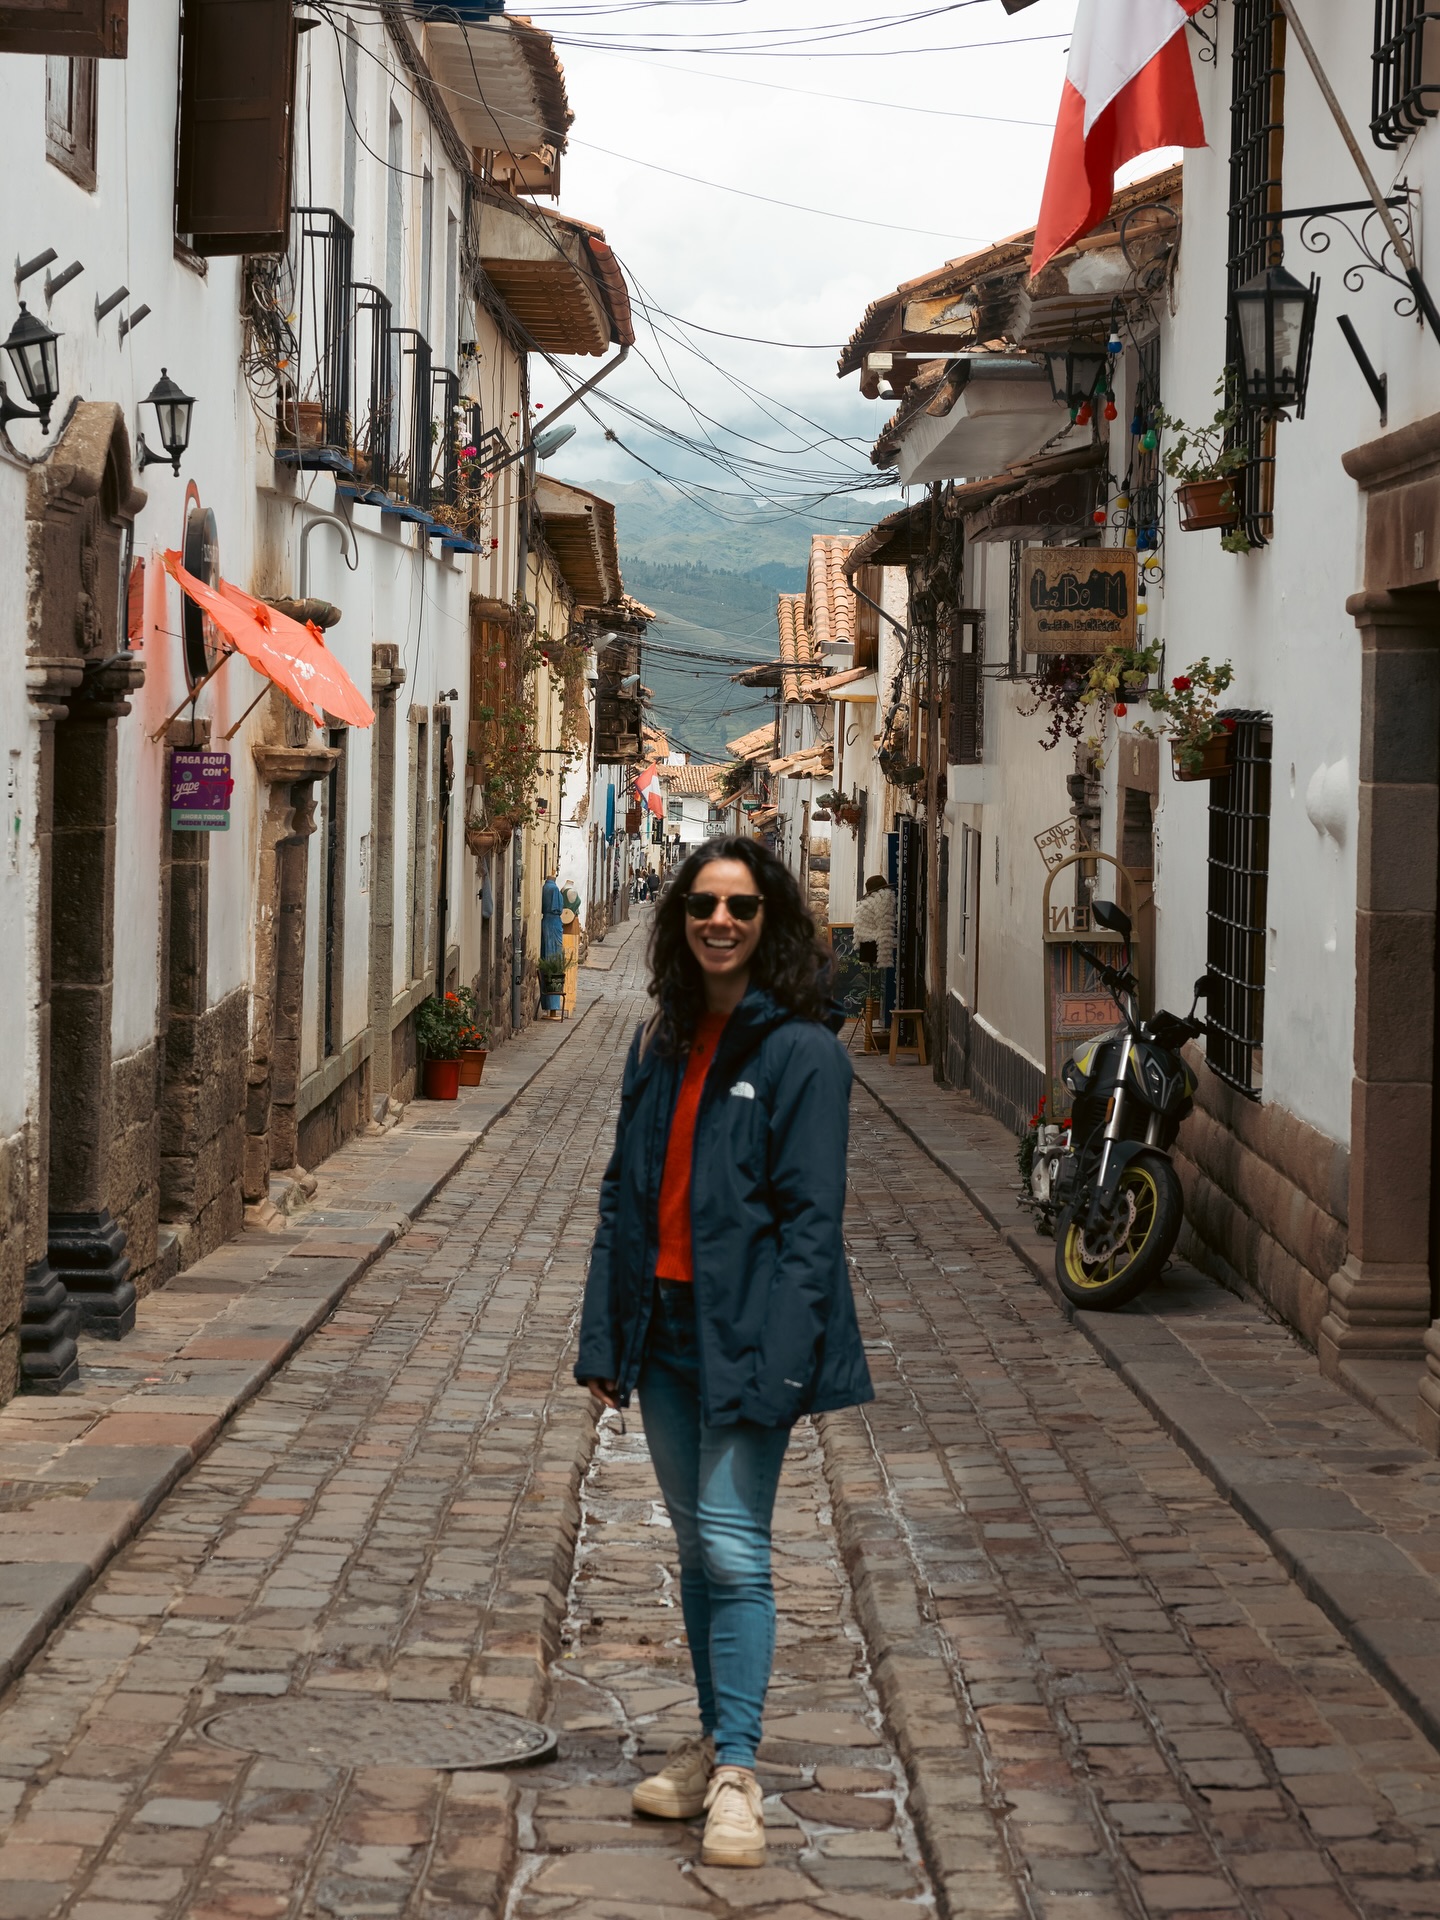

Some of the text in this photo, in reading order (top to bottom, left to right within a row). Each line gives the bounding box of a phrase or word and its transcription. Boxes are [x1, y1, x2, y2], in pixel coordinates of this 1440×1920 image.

[1034, 572, 1060, 608] La
[175, 754, 227, 765] PAGA AQUÍ
[202, 768, 222, 777] CON
[173, 782, 200, 802] yape
[1062, 1004, 1081, 1023] La
